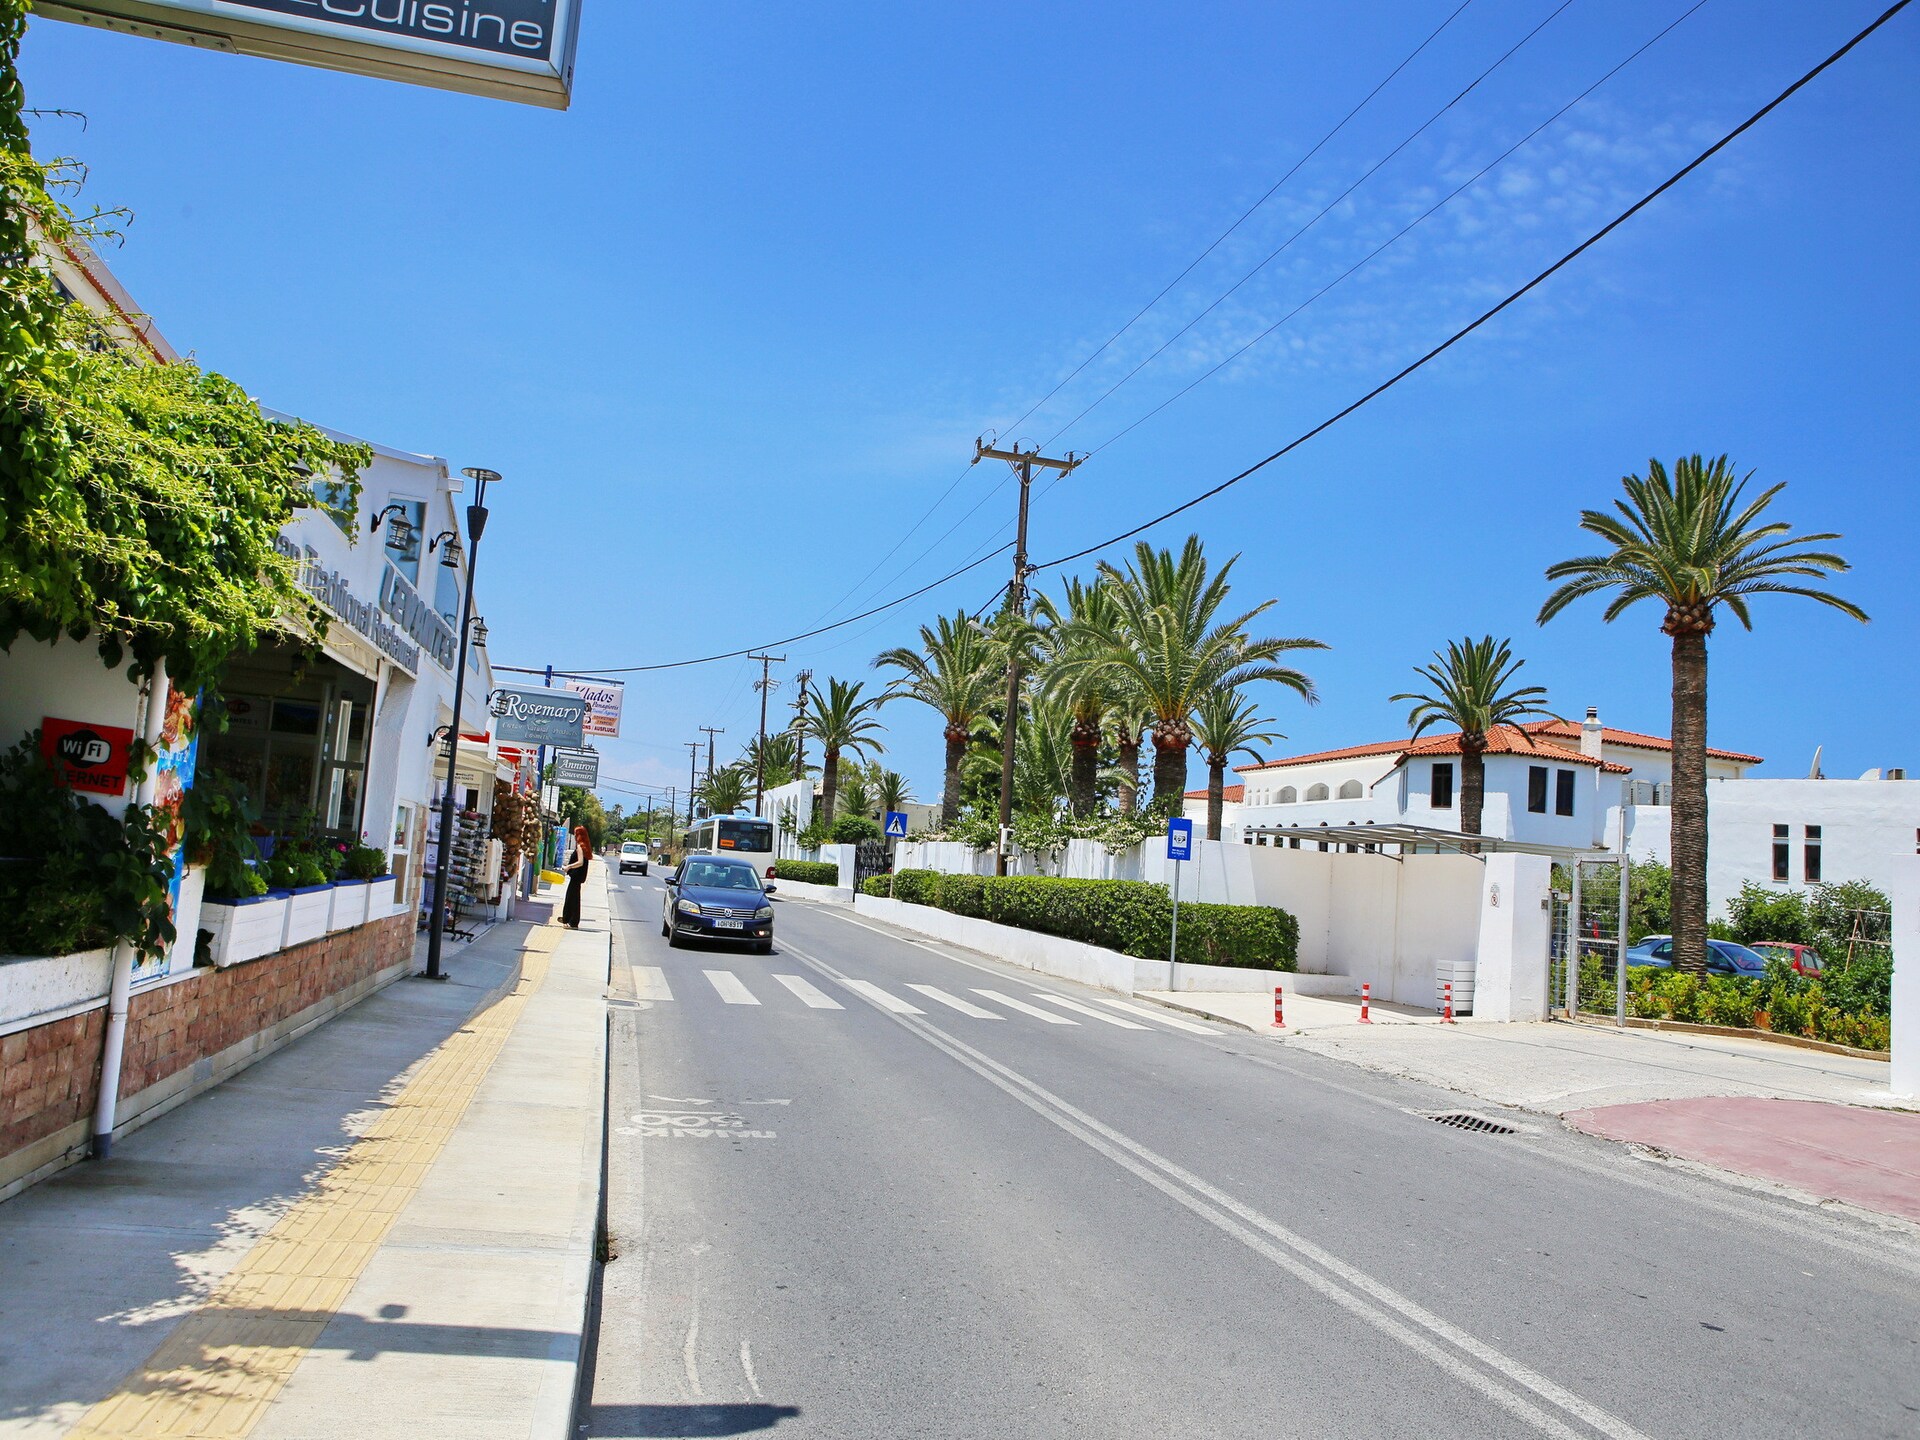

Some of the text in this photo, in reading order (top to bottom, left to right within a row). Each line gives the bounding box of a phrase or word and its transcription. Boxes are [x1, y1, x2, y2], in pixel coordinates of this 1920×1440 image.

[504, 694, 581, 724] Rosemary
[559, 759, 596, 771] Anniron
[559, 770, 594, 780] Souvenirs
